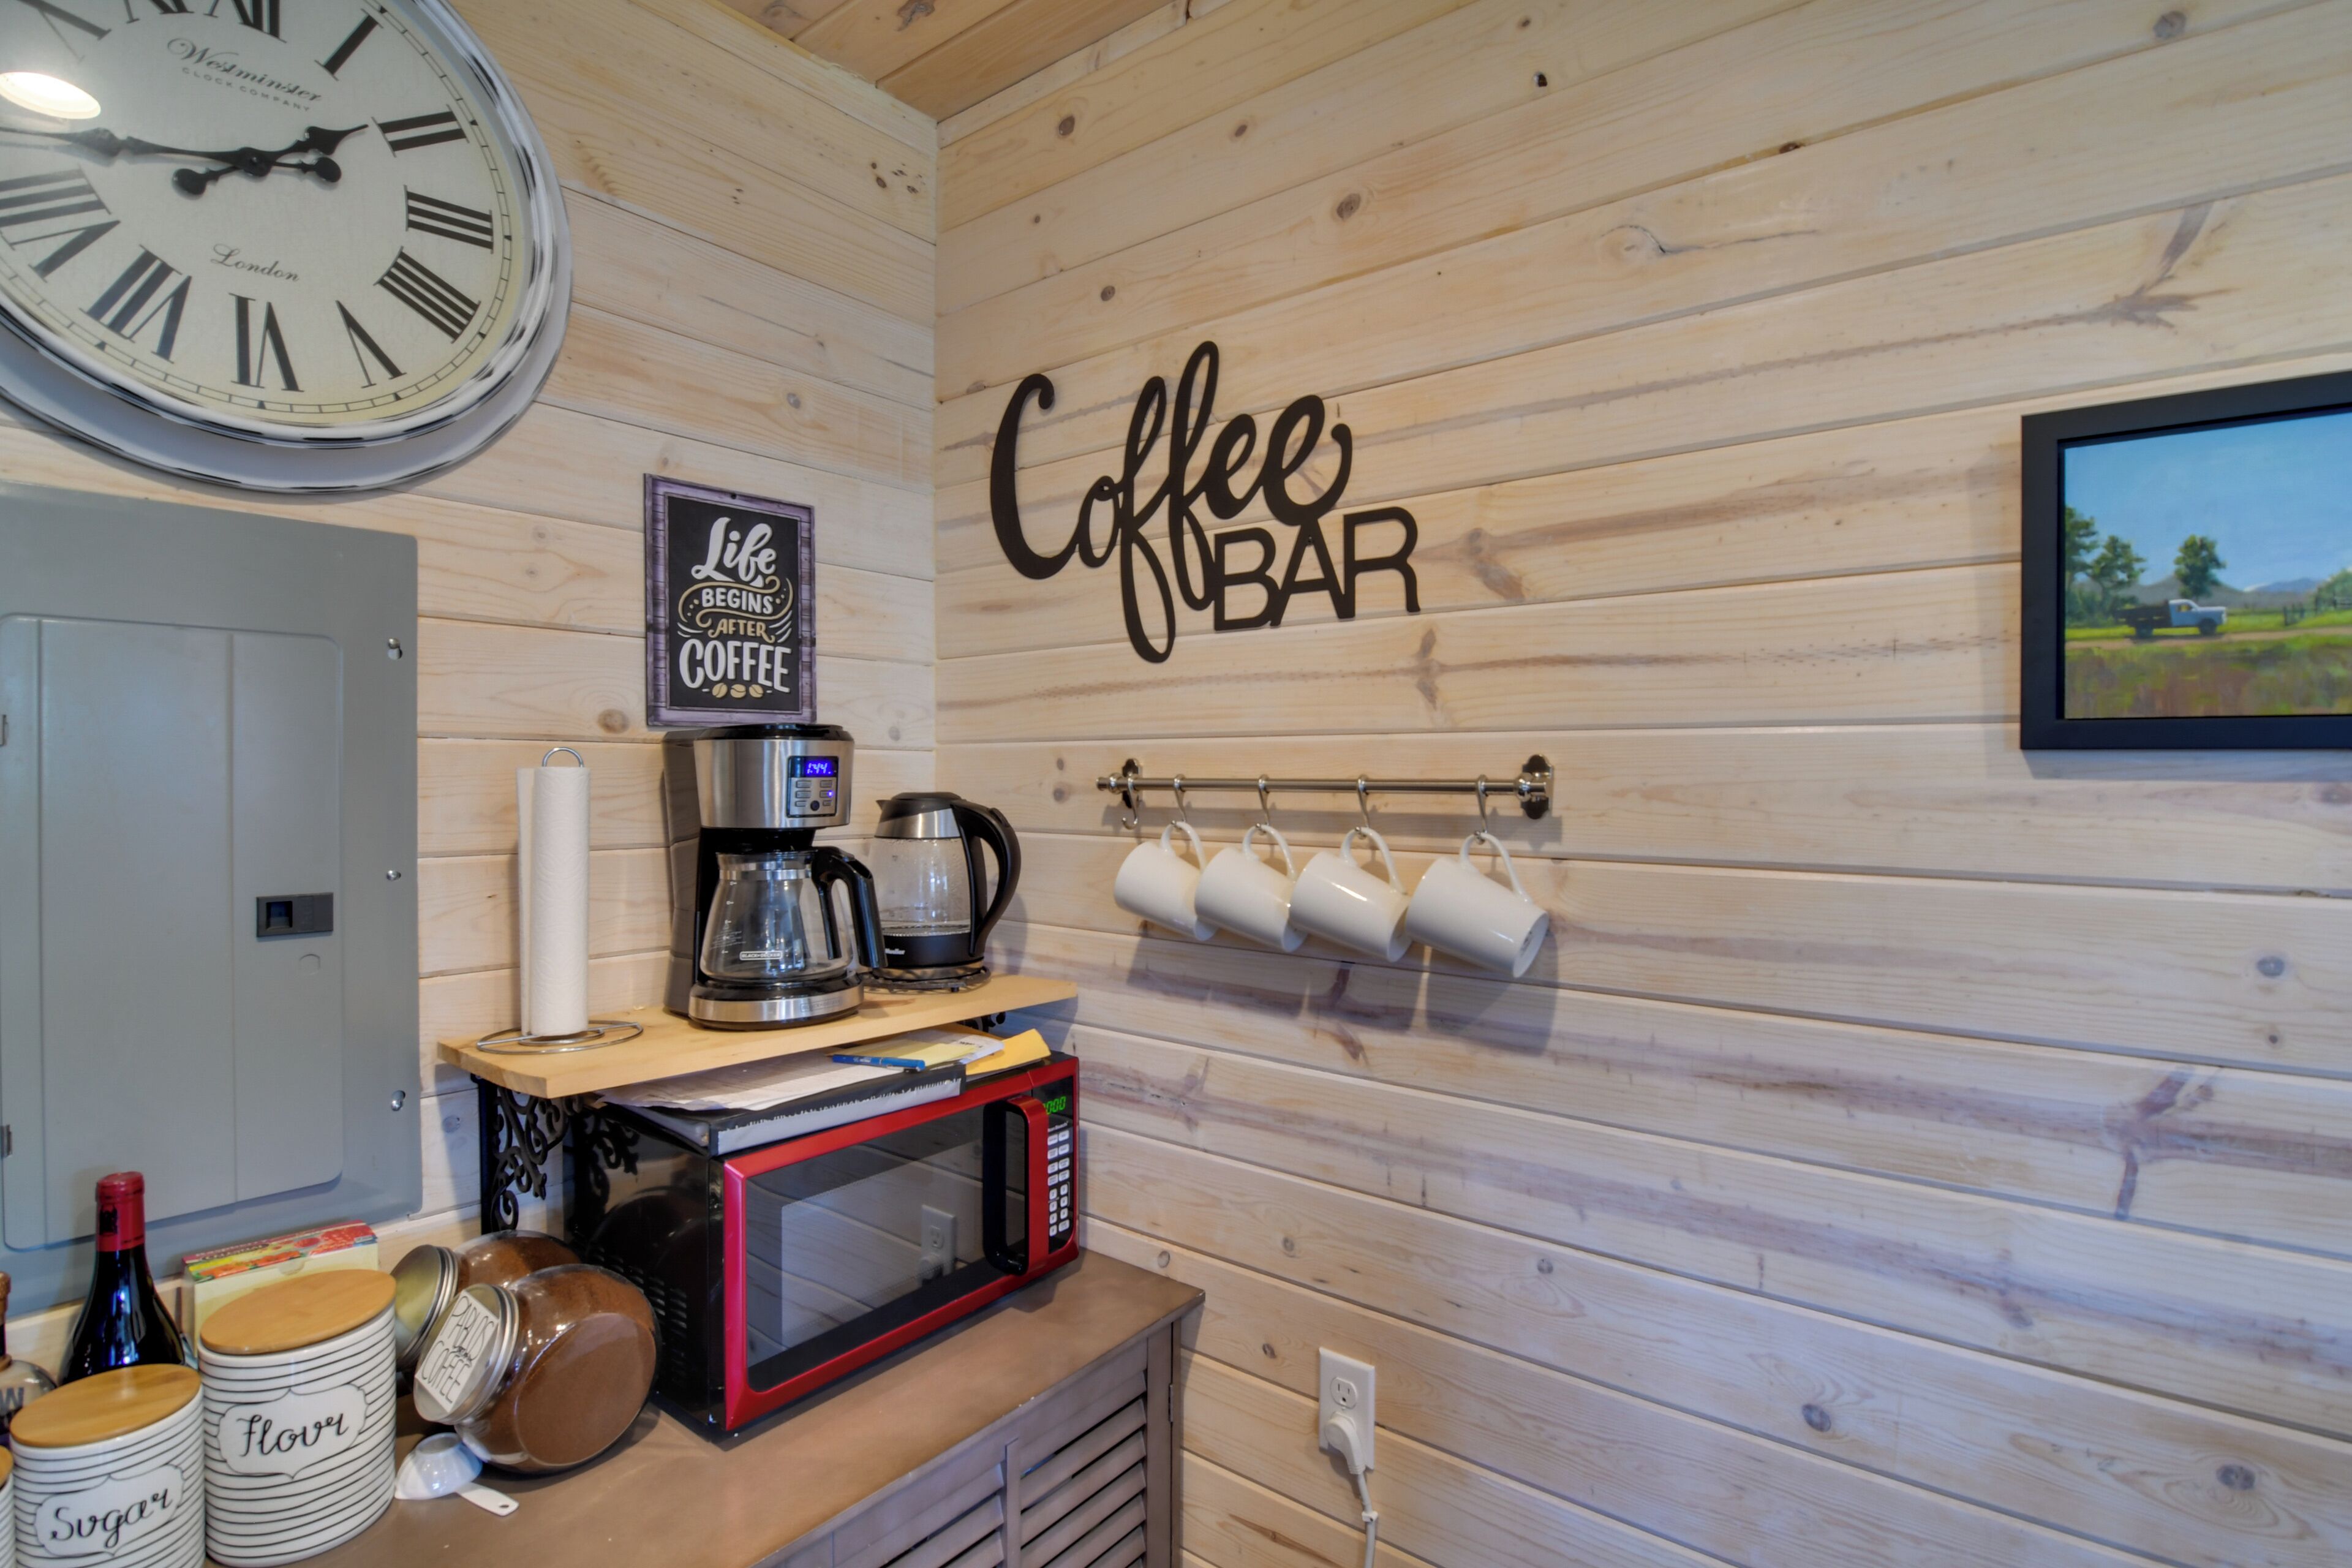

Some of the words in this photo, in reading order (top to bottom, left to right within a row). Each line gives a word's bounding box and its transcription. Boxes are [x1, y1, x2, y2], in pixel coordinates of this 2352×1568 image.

[167, 38, 322, 102] Westminster
[183, 67, 233, 89] CLOCK
[239, 85, 311, 113] COMPANY
[371, 105, 470, 157] II
[403, 185, 494, 254] III
[210, 244, 300, 282] London
[990, 341, 1353, 663] Coffee
[692, 516, 777, 587] Life
[1213, 506, 1421, 631] BAR
[701, 587, 774, 614] BEGINS
[707, 617, 776, 643] AFTER
[679, 638, 792, 693] COFFEE
[421, 1340, 472, 1404] COFFEE
